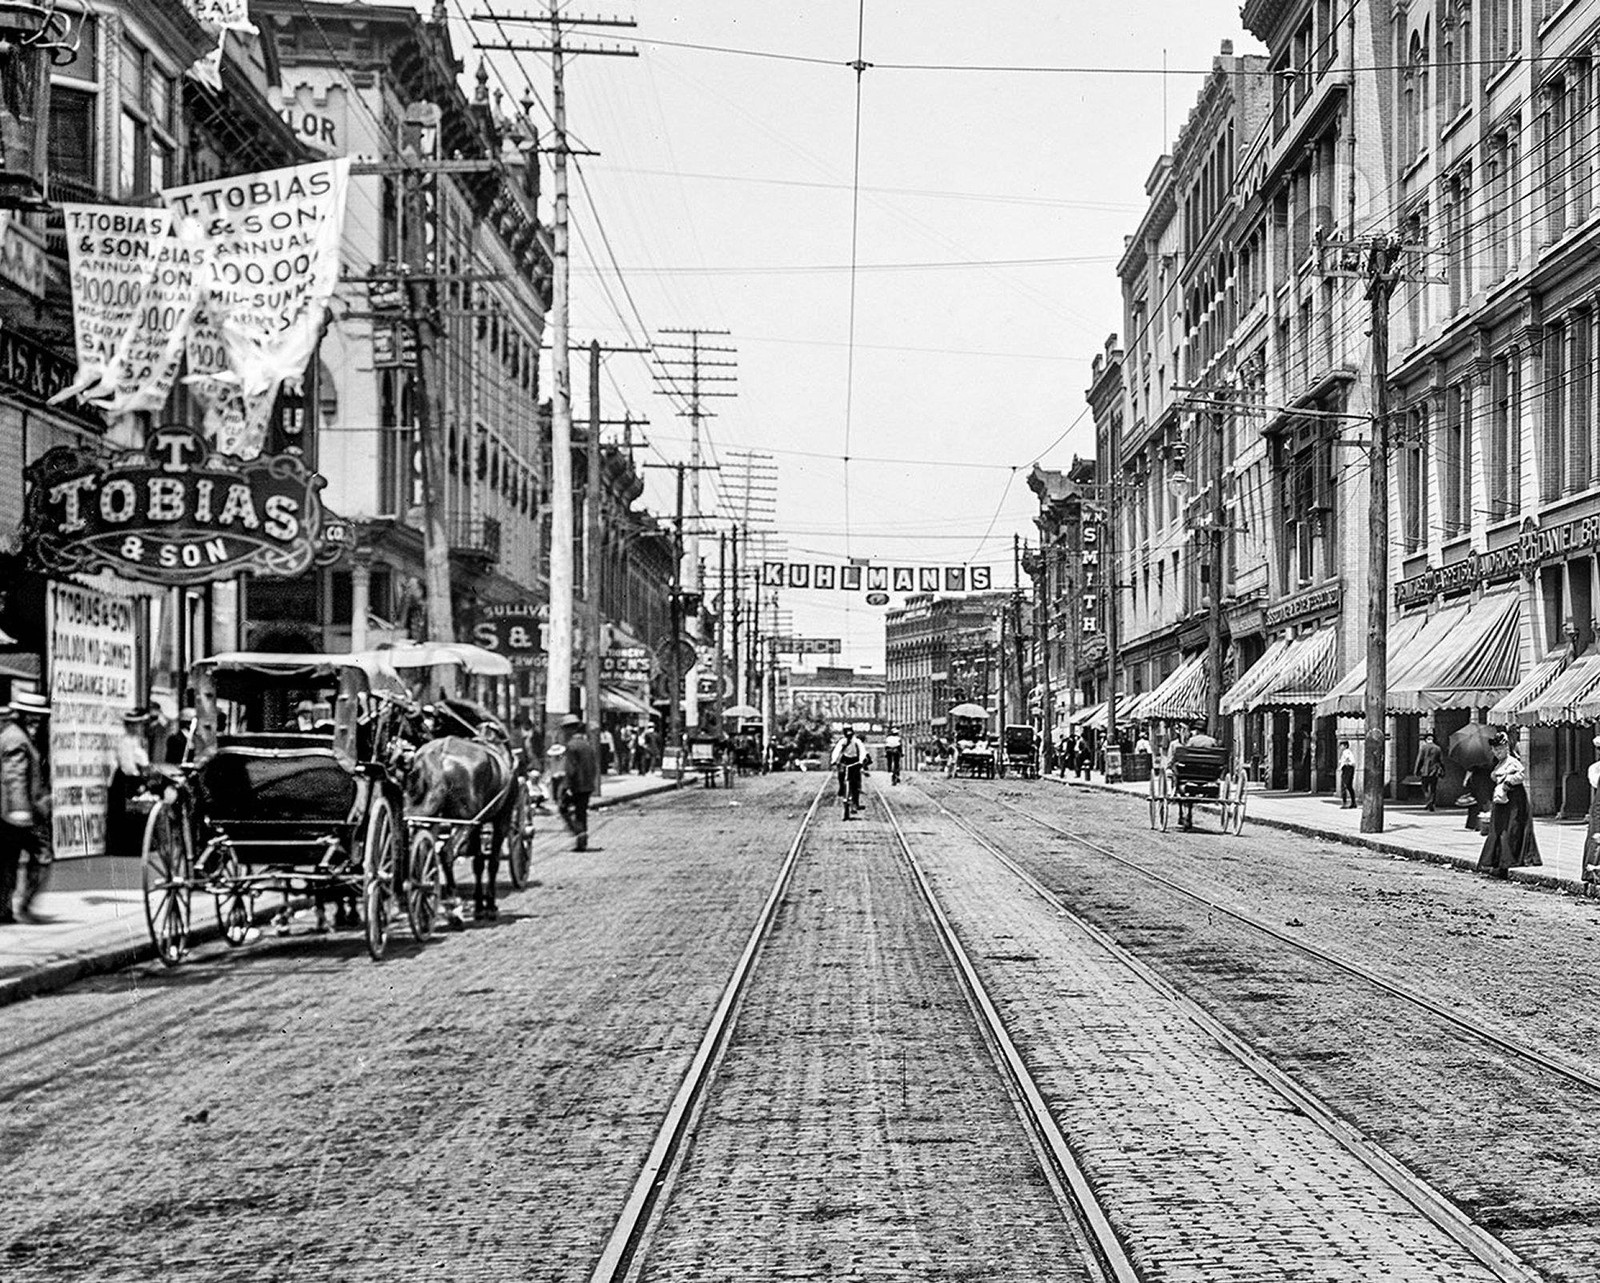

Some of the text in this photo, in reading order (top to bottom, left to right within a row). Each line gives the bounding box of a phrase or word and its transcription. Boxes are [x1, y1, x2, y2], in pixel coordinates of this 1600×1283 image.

[279, 108, 336, 147] LOR
[80, 235, 94, 253] &
[209, 218, 235, 237] &
[216, 232, 313, 258] ANNUAL
[156, 434, 195, 472] T
[49, 474, 299, 541] TOBIAS
[121, 536, 228, 567] & SON
[1538, 522, 1578, 557] DANIEL
[765, 563, 990, 592] KUHLMAN'S
[1082, 527, 1099, 632] SMITH
[59, 589, 100, 626] TOBIAS
[508, 626, 533, 648] &
